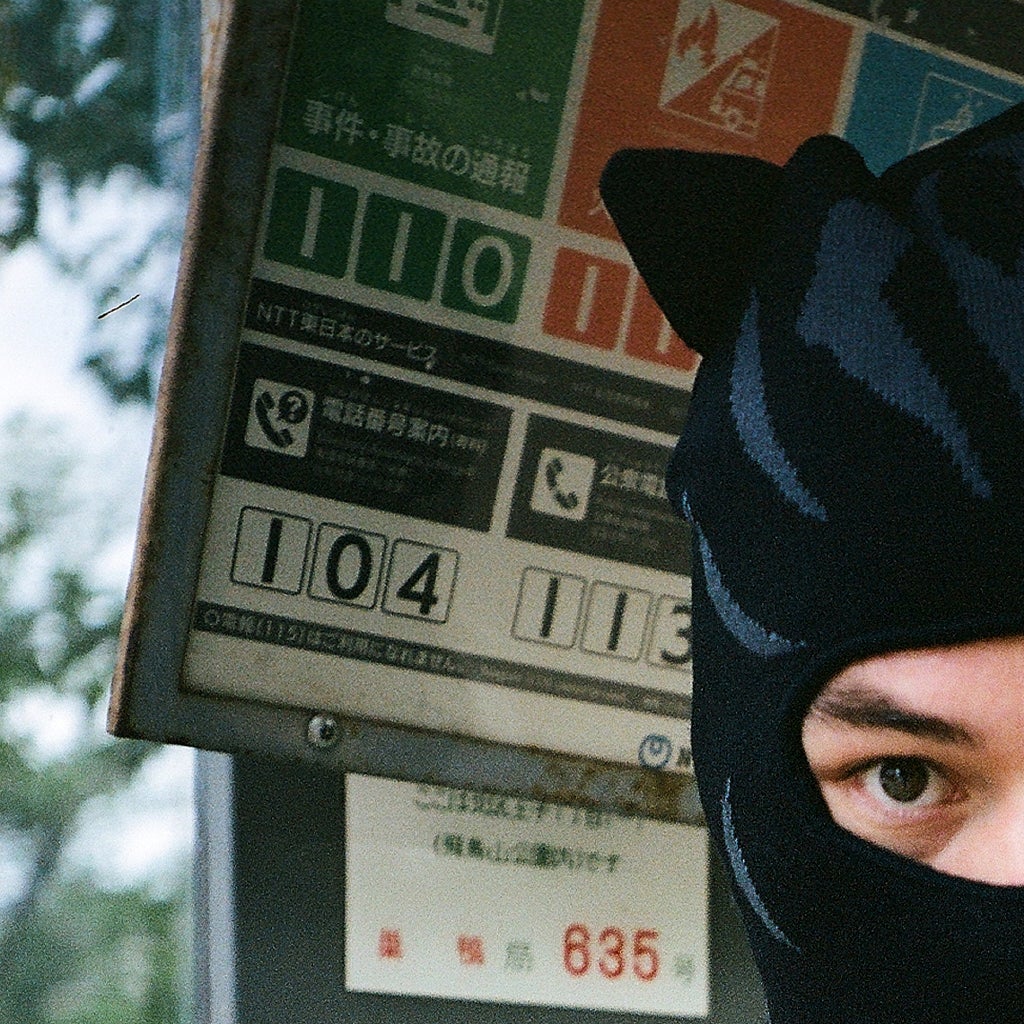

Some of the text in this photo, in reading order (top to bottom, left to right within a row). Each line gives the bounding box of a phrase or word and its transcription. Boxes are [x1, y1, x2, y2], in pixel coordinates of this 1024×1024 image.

[300, 186, 514, 308] 110
[262, 518, 440, 616] 104
[541, 577, 694, 665] 113
[563, 922, 660, 981] 635
